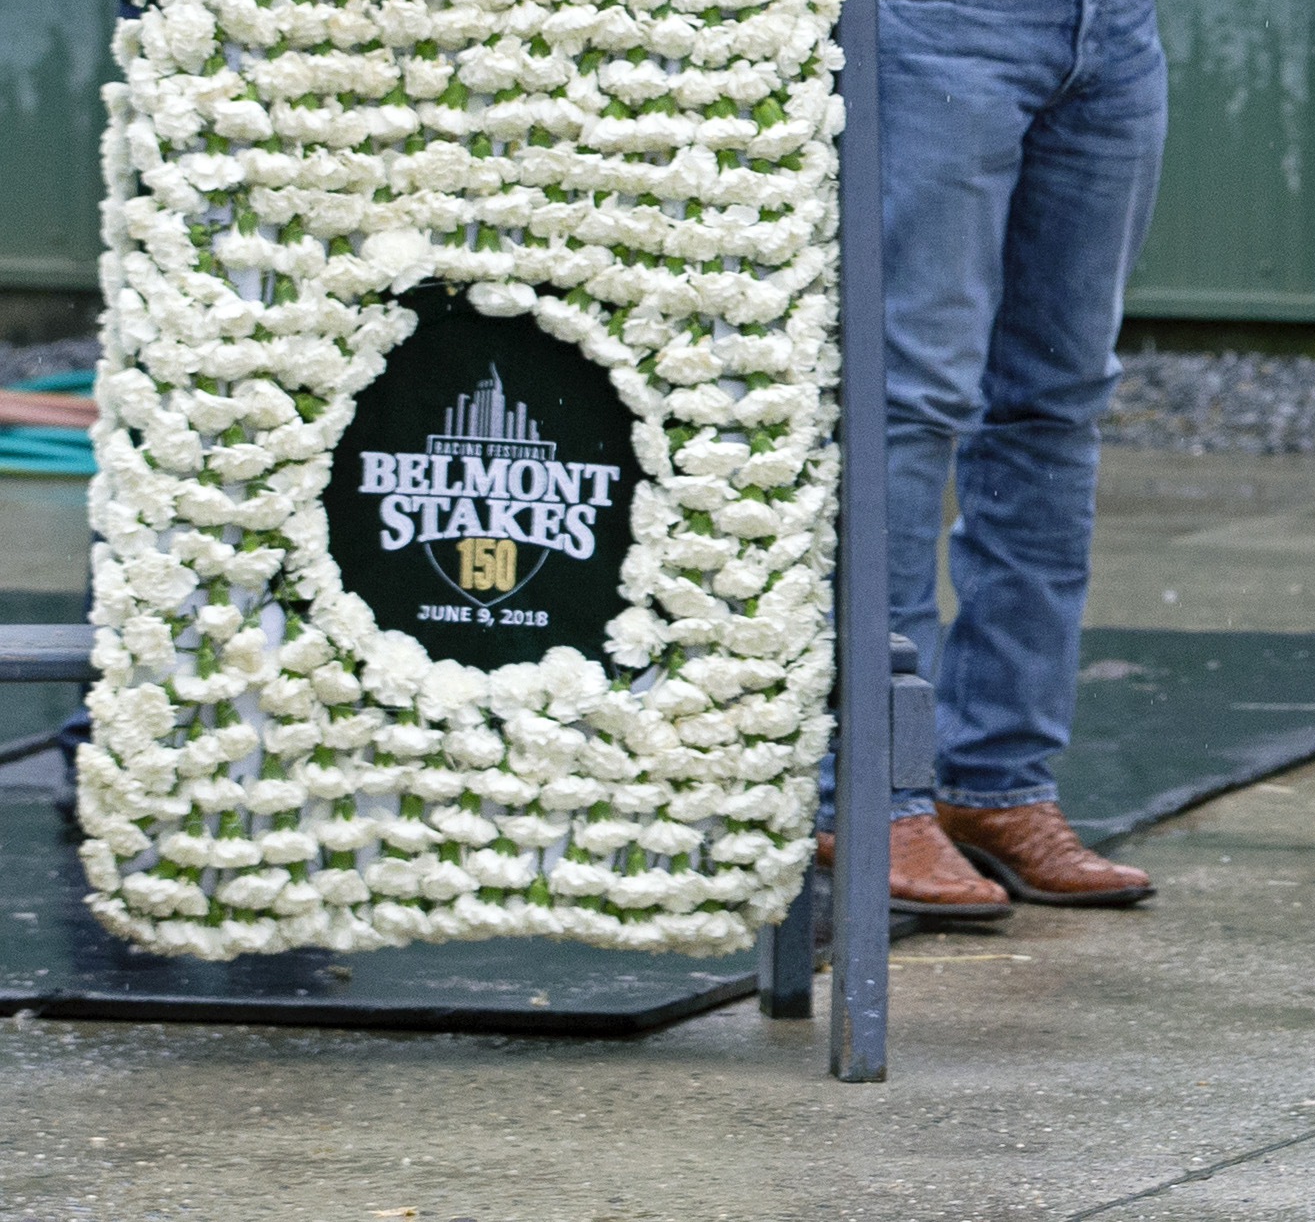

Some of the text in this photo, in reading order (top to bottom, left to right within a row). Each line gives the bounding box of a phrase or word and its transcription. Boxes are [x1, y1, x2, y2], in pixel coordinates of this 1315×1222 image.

[357, 450, 621, 507] BELMONT
[433, 440, 546, 461] RACING FESTIVAL
[379, 493, 597, 561] STAKES
[456, 536, 518, 593] 150
[416, 604, 549, 627] JUNE 9, 2018
